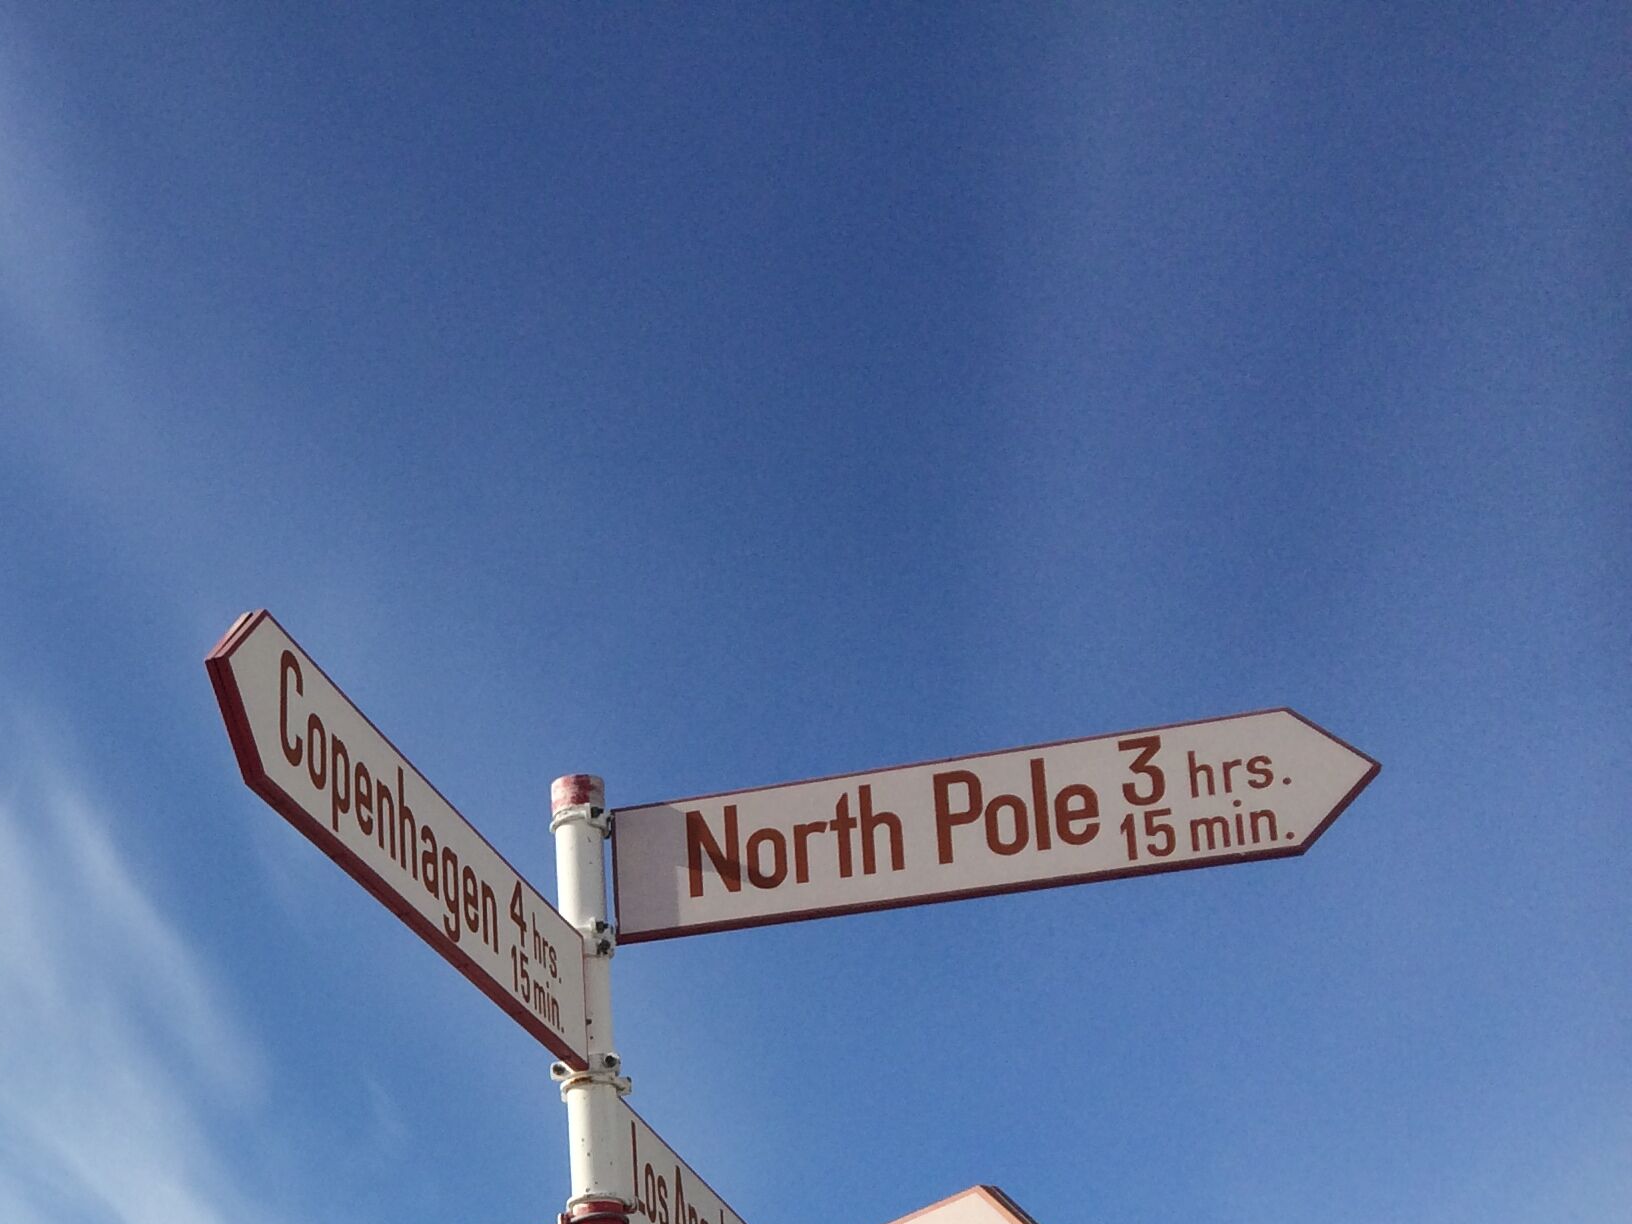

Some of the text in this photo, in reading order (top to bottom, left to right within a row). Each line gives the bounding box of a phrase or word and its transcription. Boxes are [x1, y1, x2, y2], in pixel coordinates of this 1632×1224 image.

[279, 649, 562, 984] Copenhagen 4 hrs.
[685, 735, 1294, 898] North Pole 3 hrs.
[1119, 800, 1296, 861] 15 min.
[510, 945, 565, 1033] 15 min.
